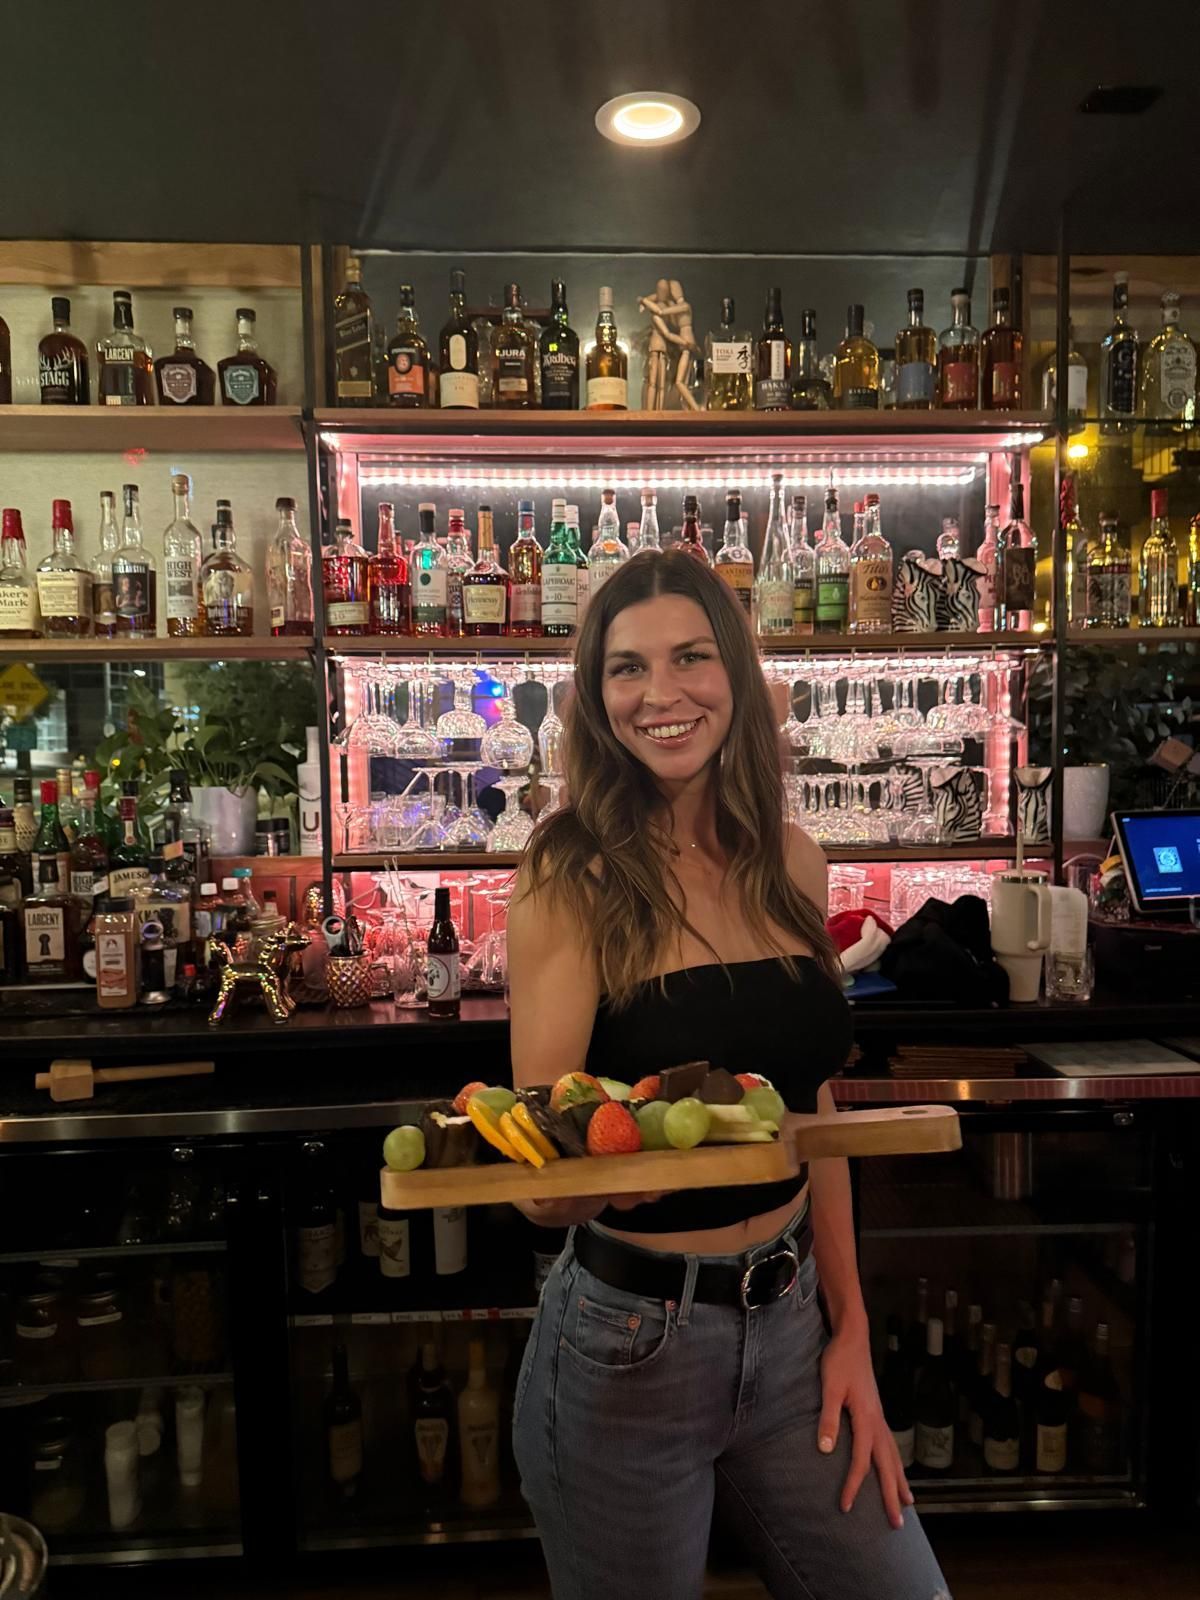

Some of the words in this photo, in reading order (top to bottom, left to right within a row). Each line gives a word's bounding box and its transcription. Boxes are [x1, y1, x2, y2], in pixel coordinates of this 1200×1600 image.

[105, 347, 134, 361] LARCENY
[499, 349, 526, 357] JURA
[542, 352, 577, 367] Ardbeg
[40, 370, 69, 387] STAGG
[167, 561, 192, 570] HIGH
[167, 570, 192, 578] WEST
[28, 912, 59, 926] LARCENY
